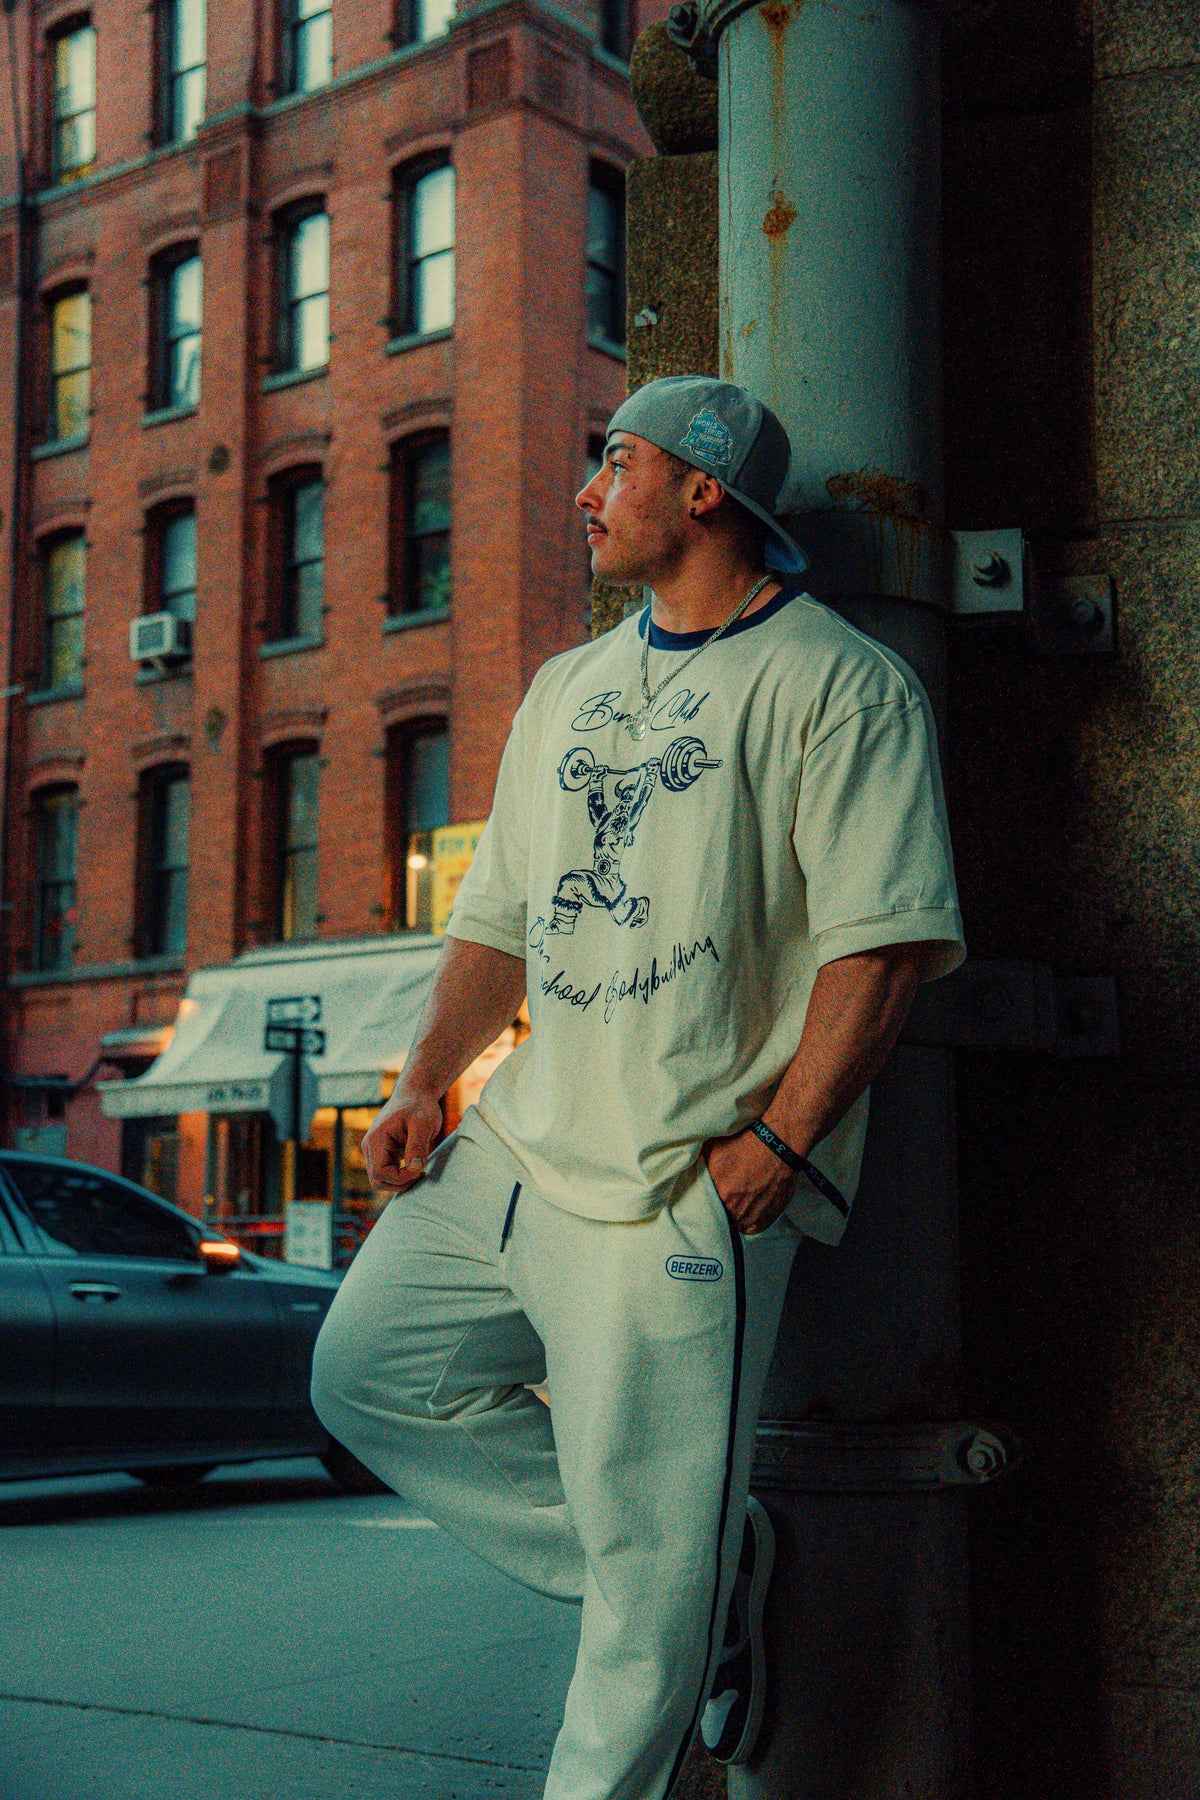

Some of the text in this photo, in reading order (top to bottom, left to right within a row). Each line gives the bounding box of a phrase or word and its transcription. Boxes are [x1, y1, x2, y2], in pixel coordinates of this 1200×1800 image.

[695, 419, 718, 429] WORLD
[704, 427, 723, 438] SERIES
[650, 688, 711, 732] Club
[540, 970, 602, 1012] chool
[604, 935, 720, 1024] Bodybuilding
[670, 1260, 719, 1277] BERZERK
